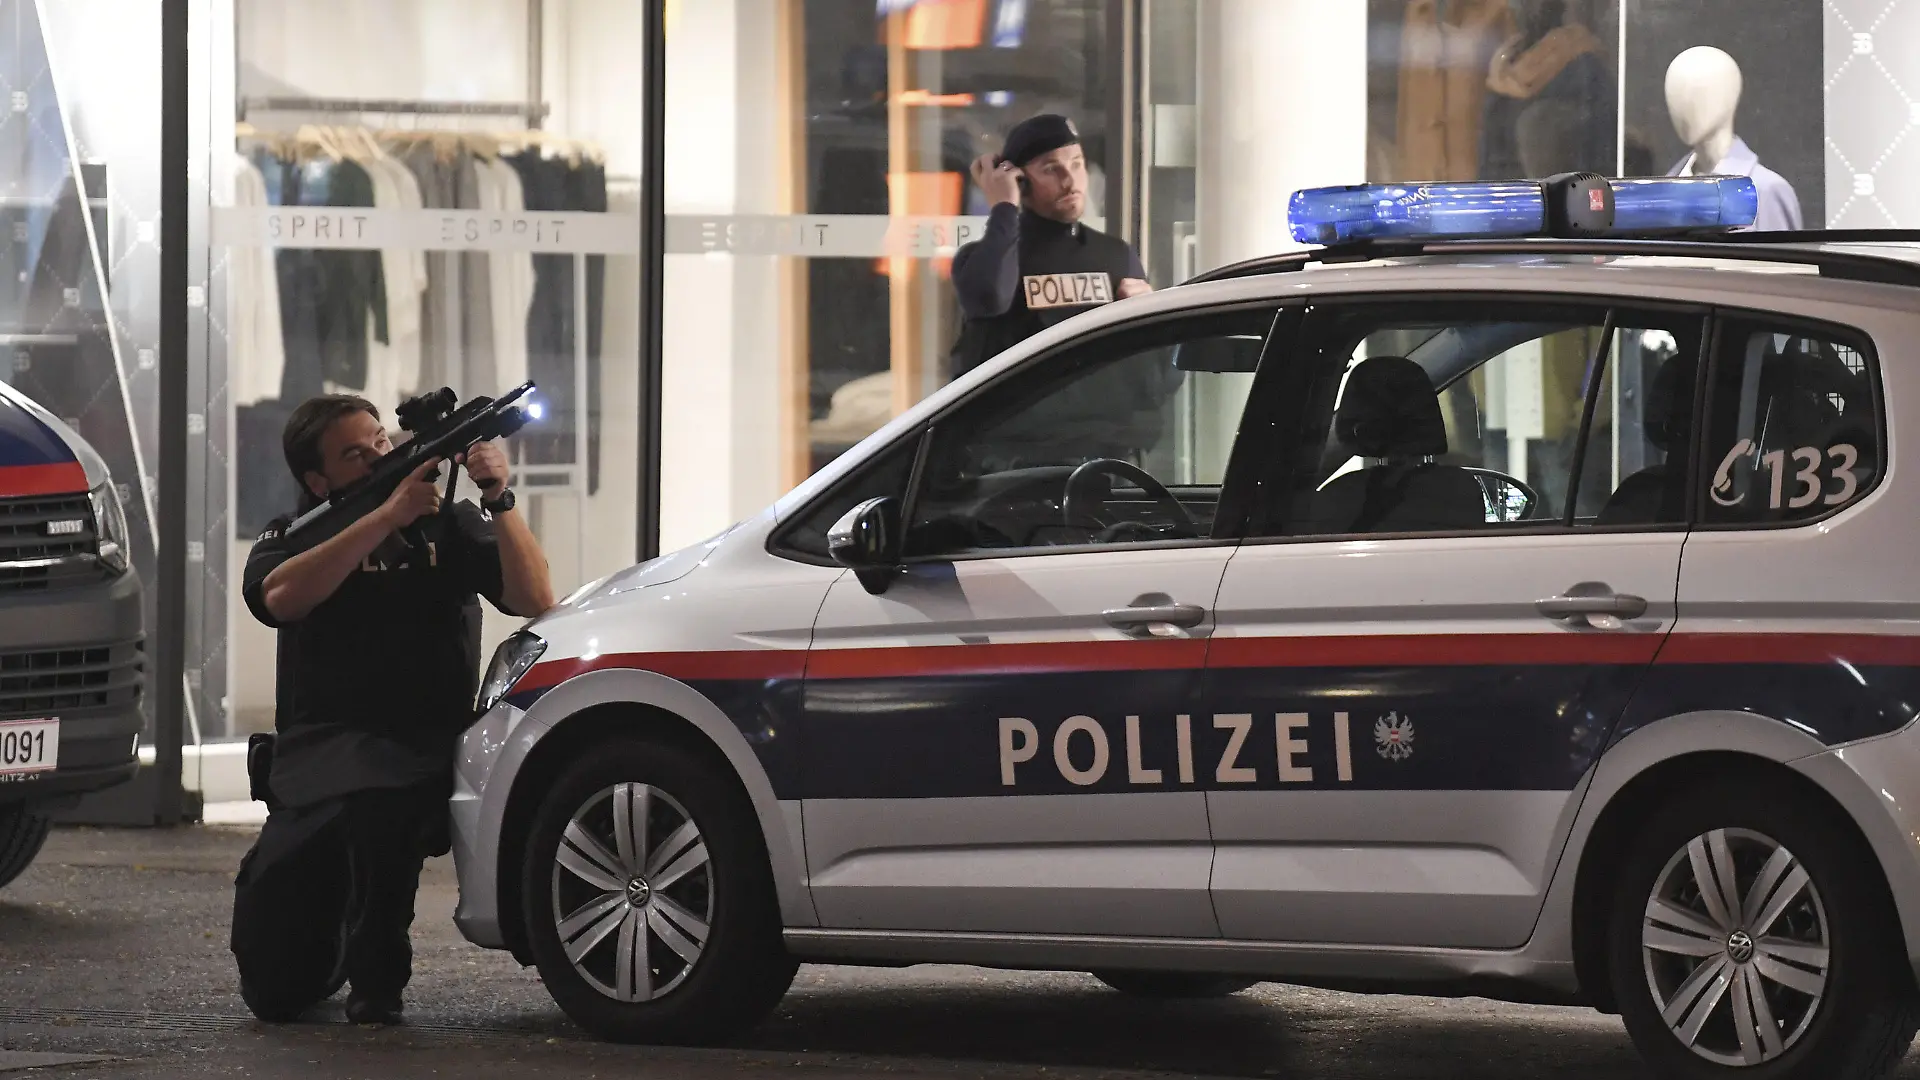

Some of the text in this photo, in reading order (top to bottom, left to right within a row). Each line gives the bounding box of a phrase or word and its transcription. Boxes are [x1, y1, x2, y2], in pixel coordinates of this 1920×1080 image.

[251, 214, 367, 239] SPRIT
[702, 221, 970, 247] ESPIT ESP
[1027, 275, 1112, 306] POLIZEI
[1762, 443, 1857, 509] 133
[0, 729, 44, 764] 091
[999, 711, 1353, 786] POLIZEI
